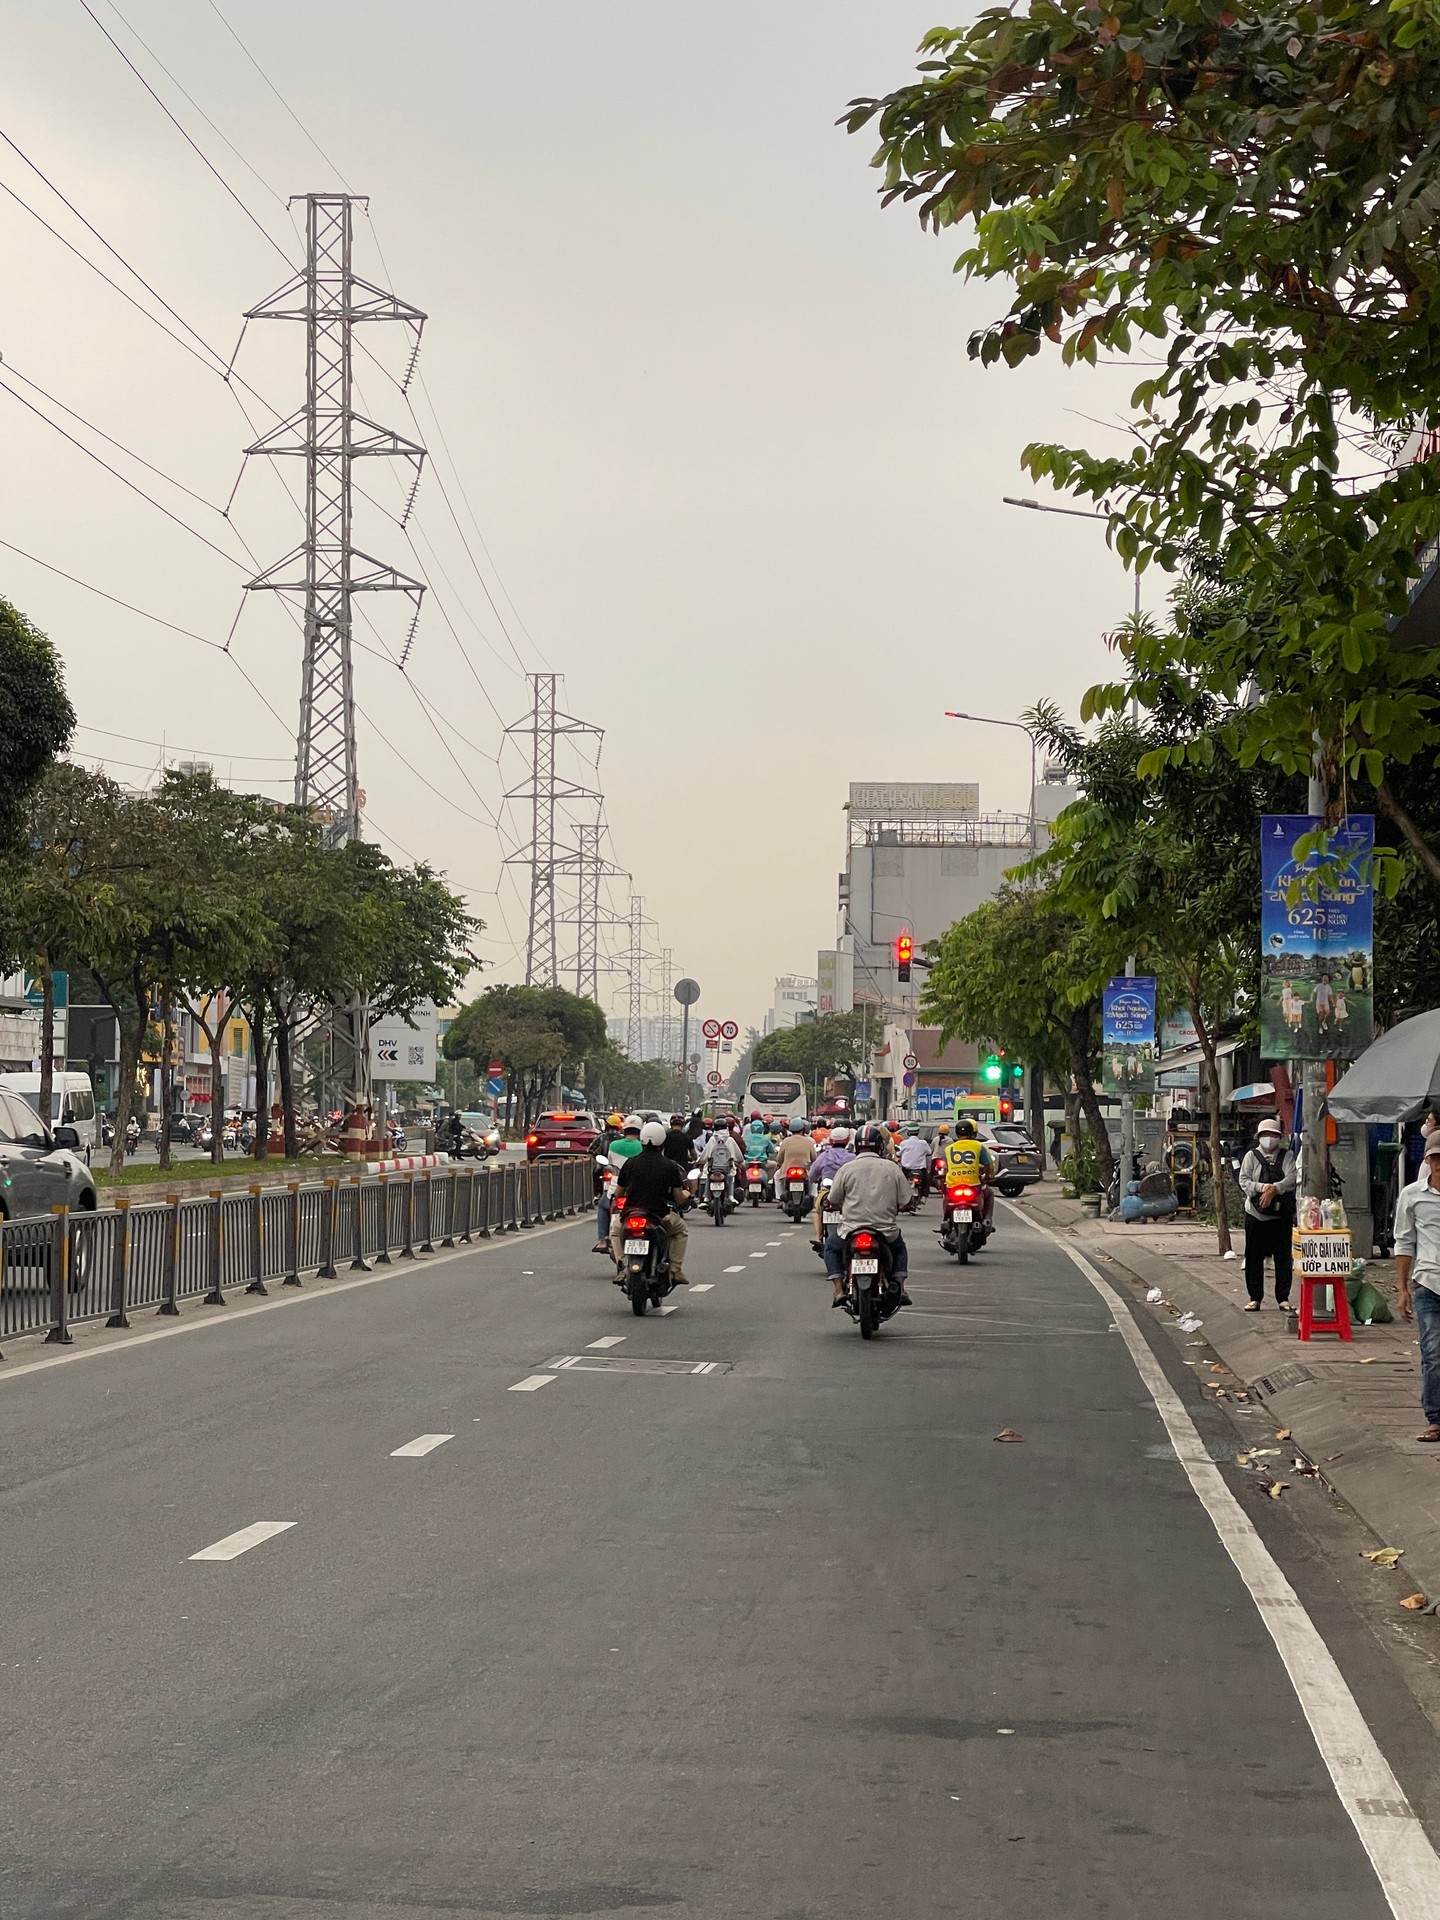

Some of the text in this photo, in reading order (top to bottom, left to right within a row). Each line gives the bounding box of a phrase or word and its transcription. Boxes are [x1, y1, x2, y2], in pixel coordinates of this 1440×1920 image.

[1288, 908, 1326, 925] 625
[726, 1026, 734, 1035] 70
[1115, 1020, 1134, 1029] 625
[378, 1039, 398, 1047] DHV
[907, 1058, 914, 1066] 50
[950, 1146, 976, 1165] be
[1302, 1236, 1349, 1258] NƯỚC GIẢI KHÁT
[1302, 1259, 1350, 1274] ƯỚP LẠNH
